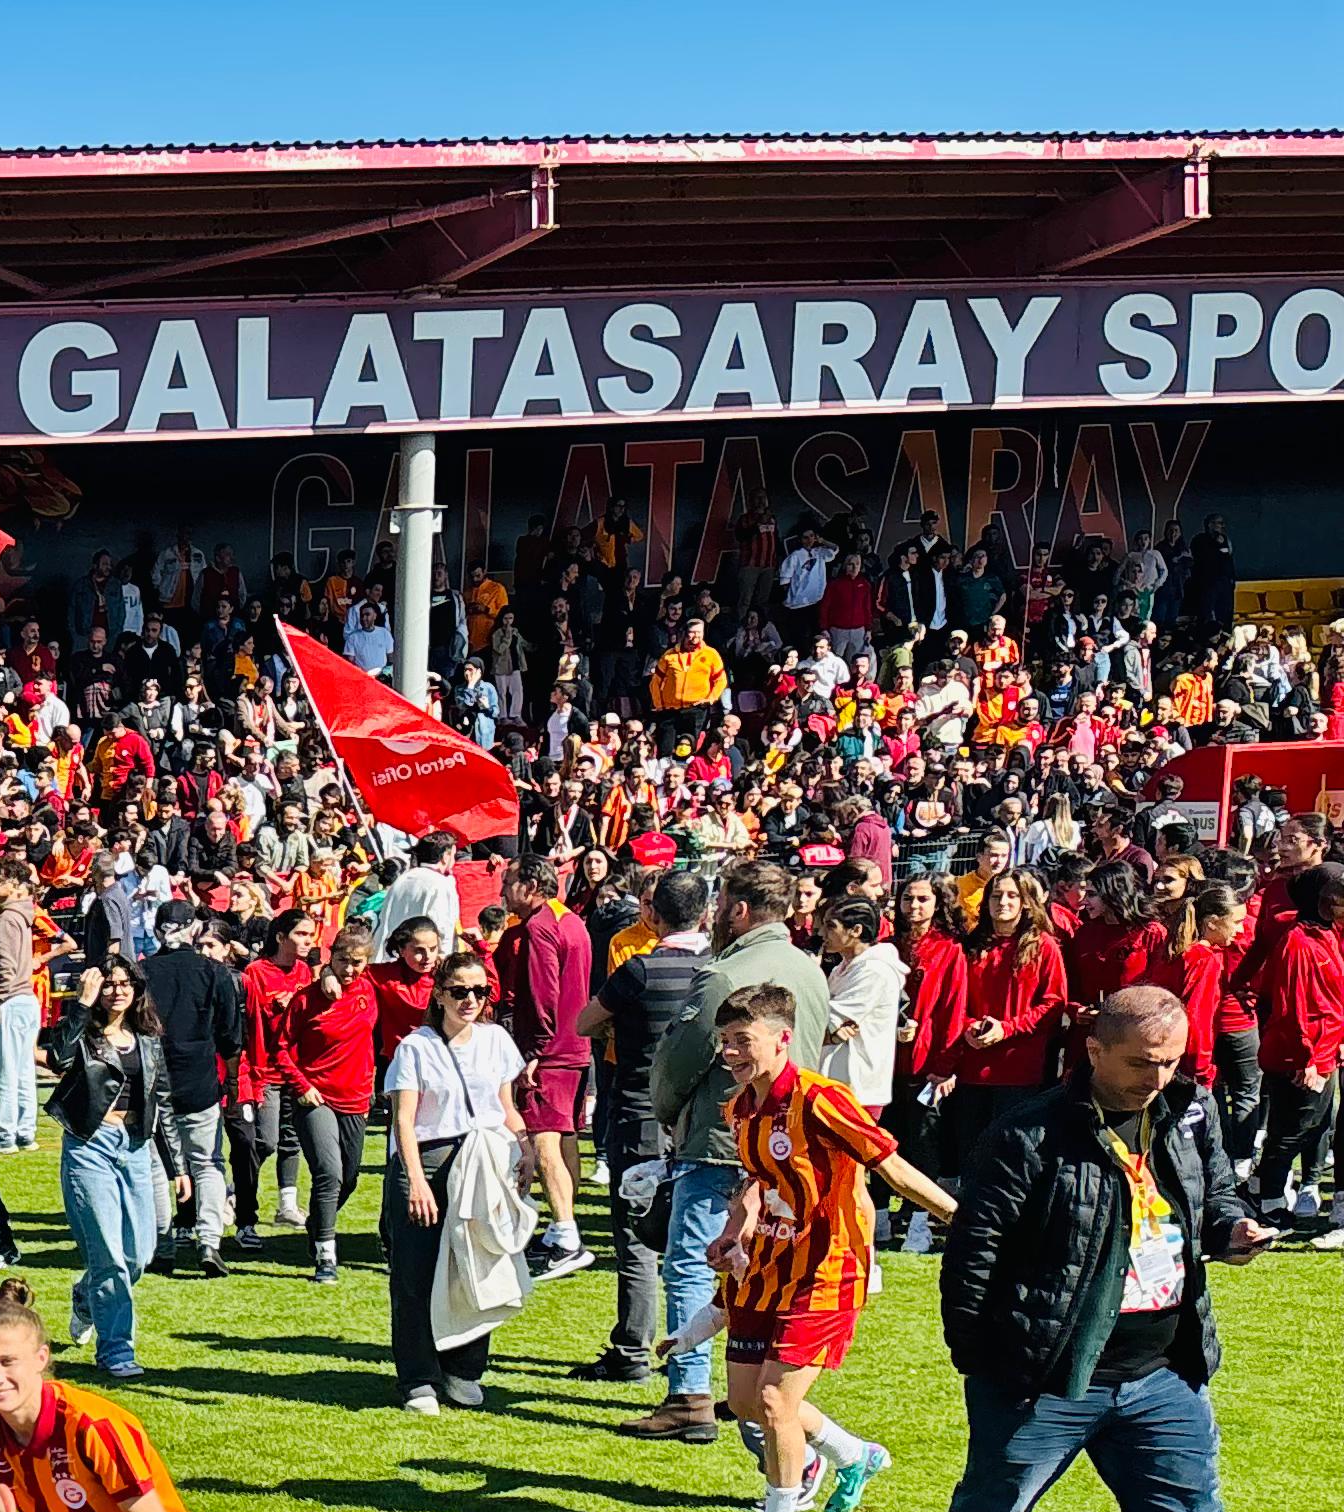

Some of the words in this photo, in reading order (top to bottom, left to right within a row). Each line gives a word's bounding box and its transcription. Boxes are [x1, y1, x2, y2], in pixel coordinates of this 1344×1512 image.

[18, 296, 1062, 437] GALATASARAY
[1098, 288, 1344, 400] SPO
[270, 419, 1212, 590] GLATASARAY
